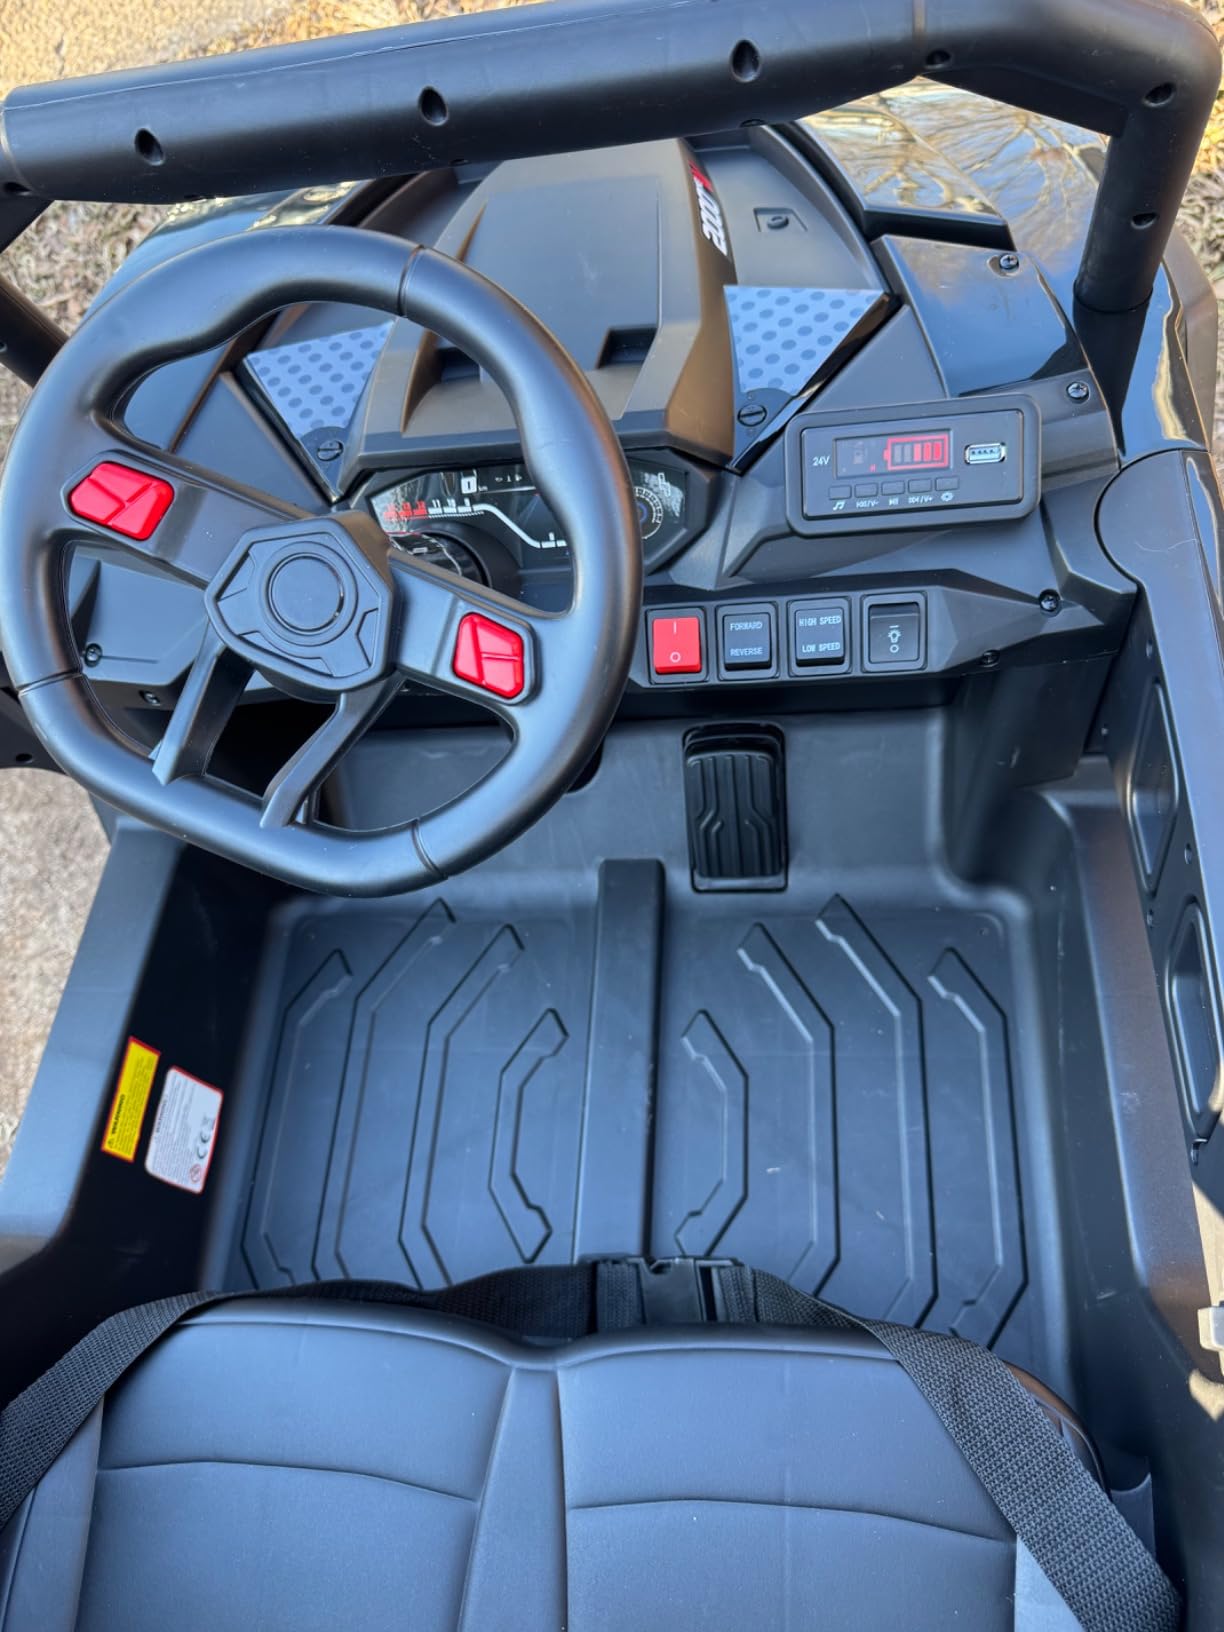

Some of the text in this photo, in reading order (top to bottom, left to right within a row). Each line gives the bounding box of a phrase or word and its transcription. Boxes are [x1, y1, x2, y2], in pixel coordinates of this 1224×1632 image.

[812, 455, 831, 467] 24V
[729, 621, 763, 631] FORWARD
[799, 615, 842, 627] HIGH SPEED
[729, 647, 763, 657] REVERSE
[801, 641, 841, 653] LOW SPEED
